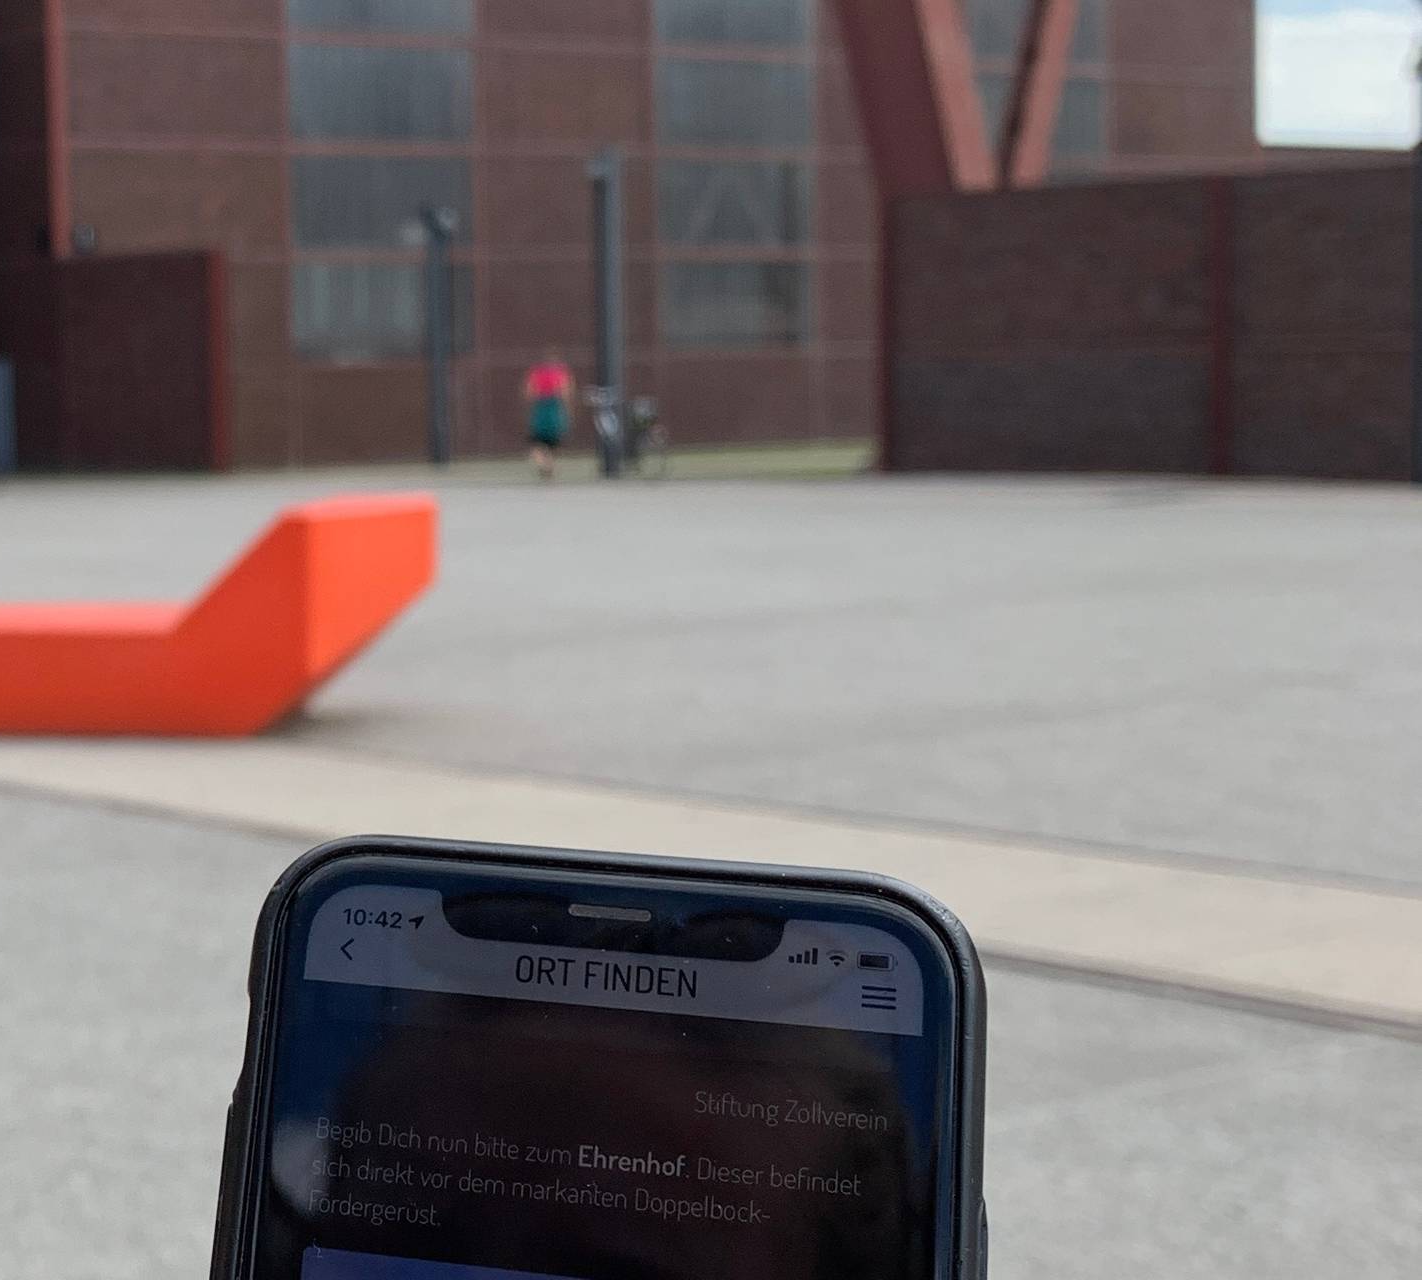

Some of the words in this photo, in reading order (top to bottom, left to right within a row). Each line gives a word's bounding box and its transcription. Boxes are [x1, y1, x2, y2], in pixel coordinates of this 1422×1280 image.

[343, 908, 403, 929] 10:42
[515, 955, 575, 986] ORT
[583, 961, 698, 999] FINDEN
[694, 1090, 779, 1128] Stiftung
[784, 1098, 888, 1131] Zollverein
[315, 1116, 372, 1149] Begib
[378, 1122, 422, 1150] Dich
[428, 1134, 468, 1155] nun
[474, 1132, 520, 1161] bitte
[524, 1144, 572, 1166] zum
[578, 1144, 690, 1179] Ehrenhof.
[697, 1156, 763, 1186] Dieser
[769, 1163, 862, 1198] befindet
[311, 1153, 351, 1178] sich
[356, 1156, 415, 1186] direkt
[419, 1170, 453, 1190] vor
[458, 1168, 506, 1196] dem
[511, 1179, 628, 1211] markanten
[634, 1187, 771, 1225] Doppelbock-
